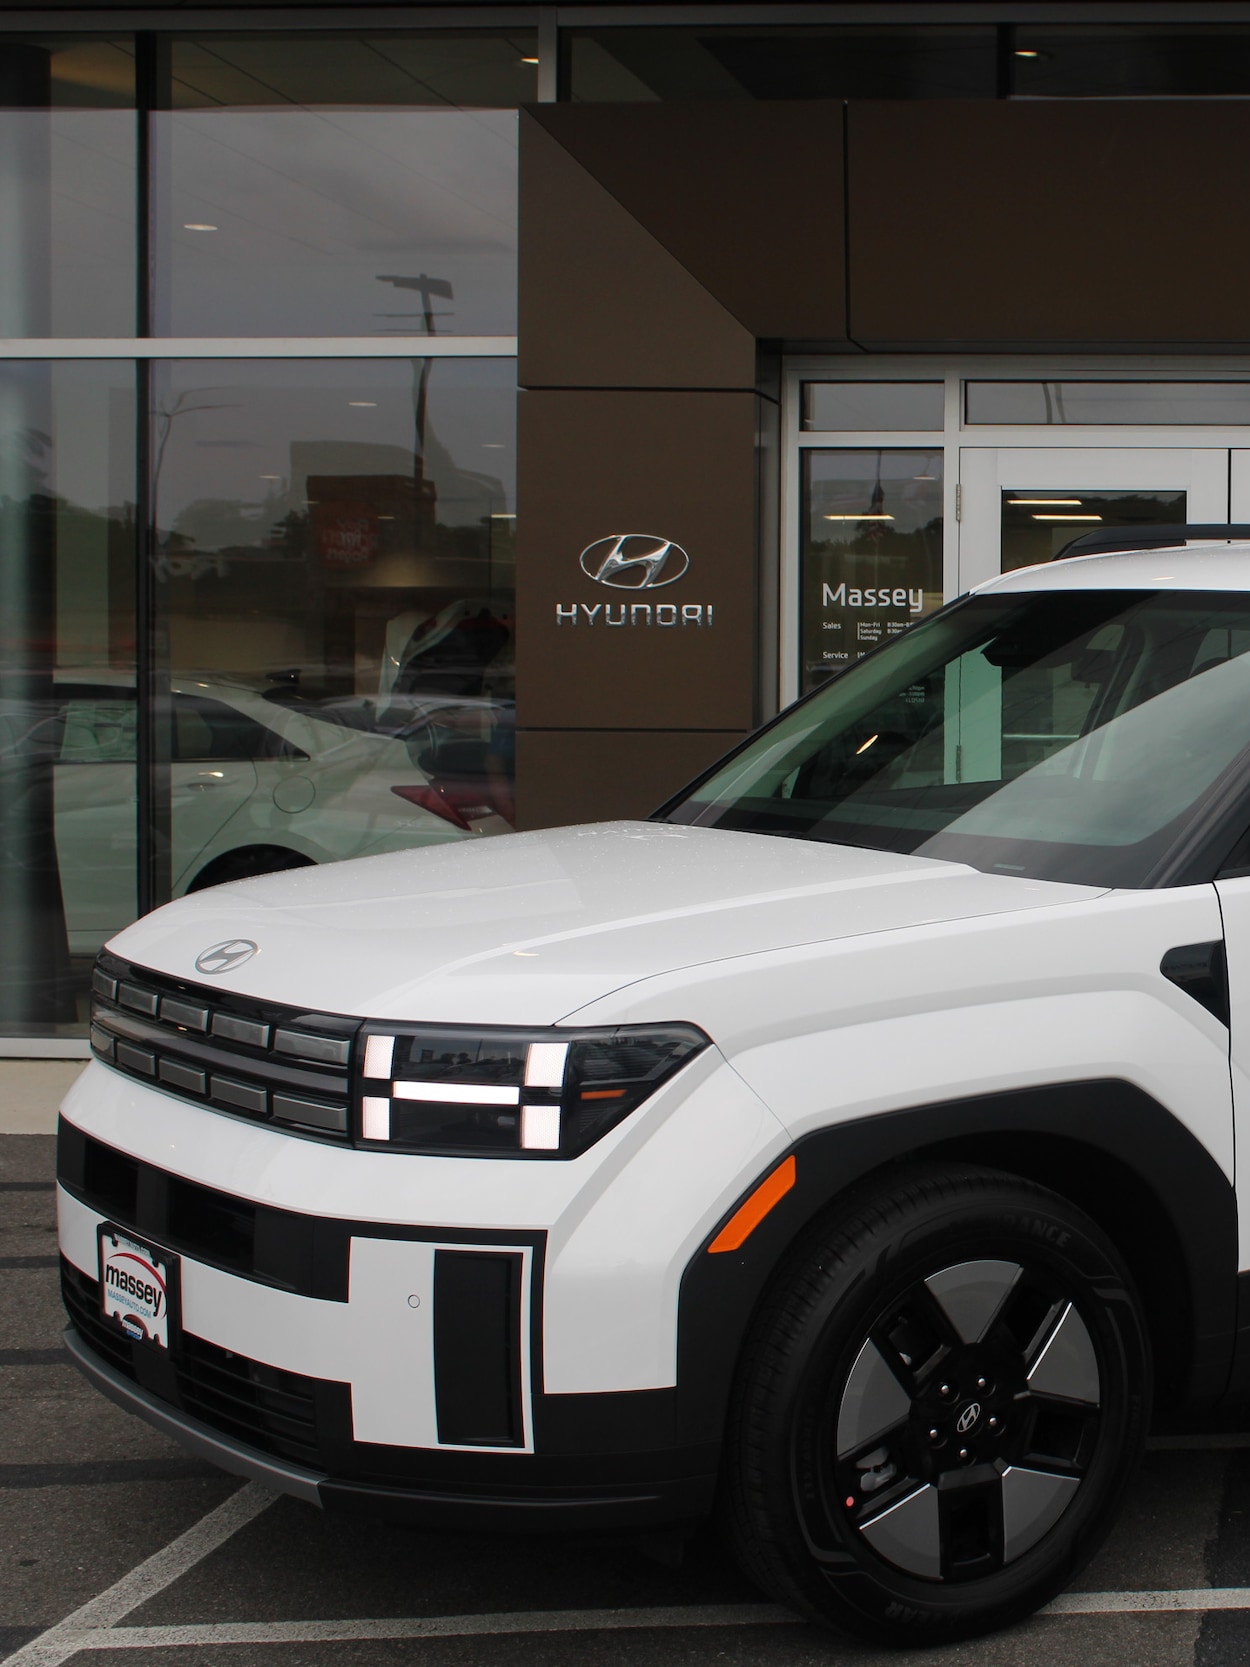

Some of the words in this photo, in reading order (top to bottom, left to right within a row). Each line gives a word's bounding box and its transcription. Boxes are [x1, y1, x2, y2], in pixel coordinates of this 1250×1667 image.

[822, 583, 924, 613] Massey
[555, 603, 713, 627] HYUNDAI
[822, 622, 842, 630] Sales
[106, 1264, 162, 1317] massey
